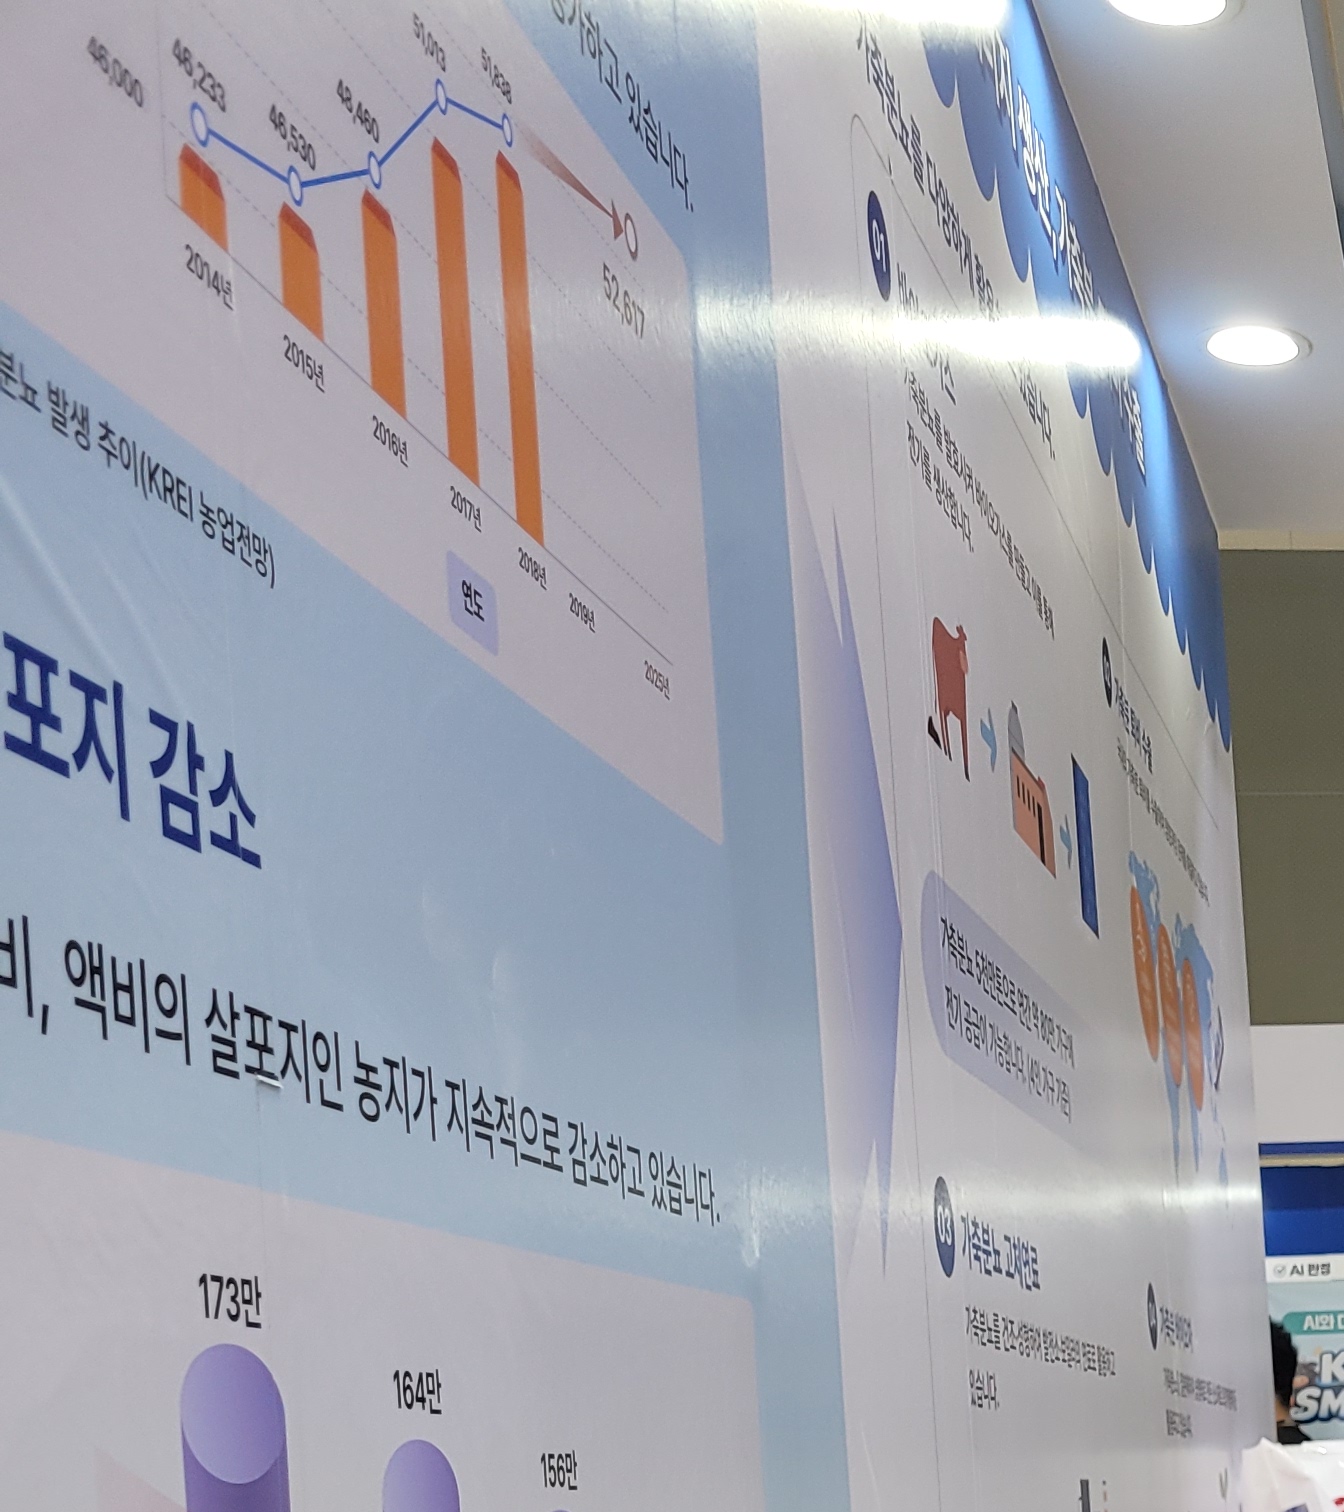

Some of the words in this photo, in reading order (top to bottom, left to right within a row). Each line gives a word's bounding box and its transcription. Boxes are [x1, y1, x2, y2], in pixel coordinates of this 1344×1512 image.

[86, 36, 144, 109] 46,000
[411, 14, 447, 74] 51,013
[171, 38, 227, 113] 46,233
[268, 104, 317, 171] 46,530
[335, 78, 381, 143] 48,460
[625, 72, 693, 213] 있습니다.
[926, 150, 975, 297] 다양하게
[184, 244, 234, 311] 2014년
[602, 263, 646, 340] 52,617
[282, 334, 325, 393] 2015년
[371, 414, 409, 467] 2016년
[46, 379, 92, 451] 발생
[97, 422, 194, 524] 추이(KREI
[199, 491, 276, 588] 농업전망)
[449, 485, 482, 532] 2017년
[516, 546, 548, 590] 2018년
[459, 578, 486, 623] 연도
[567, 593, 596, 633] 2019년
[2, 630, 131, 821] 포지
[148, 707, 262, 870] 감소
[940, 916, 974, 978] 가축분뇨
[945, 985, 963, 1037] 전기
[964, 1006, 988, 1058] 공급이
[63, 939, 192, 1066] 액비의
[204, 988, 344, 1112] 살포지인
[353, 1039, 438, 1142] 농지가
[445, 1078, 564, 1173] 지속적으로
[568, 1121, 646, 1199] 감소하고
[647, 1150, 722, 1228] 있습니다.
[961, 1213, 1002, 1278] 가축분뇨
[1003, 1234, 1041, 1292] 고체연료
[1290, 1263, 1304, 1276] AI
[1307, 1262, 1331, 1276] 판정
[198, 1273, 263, 1329] 173만
[965, 1304, 1001, 1351] 가축분뇨를
[393, 1369, 443, 1415] 164만
[969, 1369, 1000, 1412] 있습니다.
[540, 1449, 578, 1491] 156만
